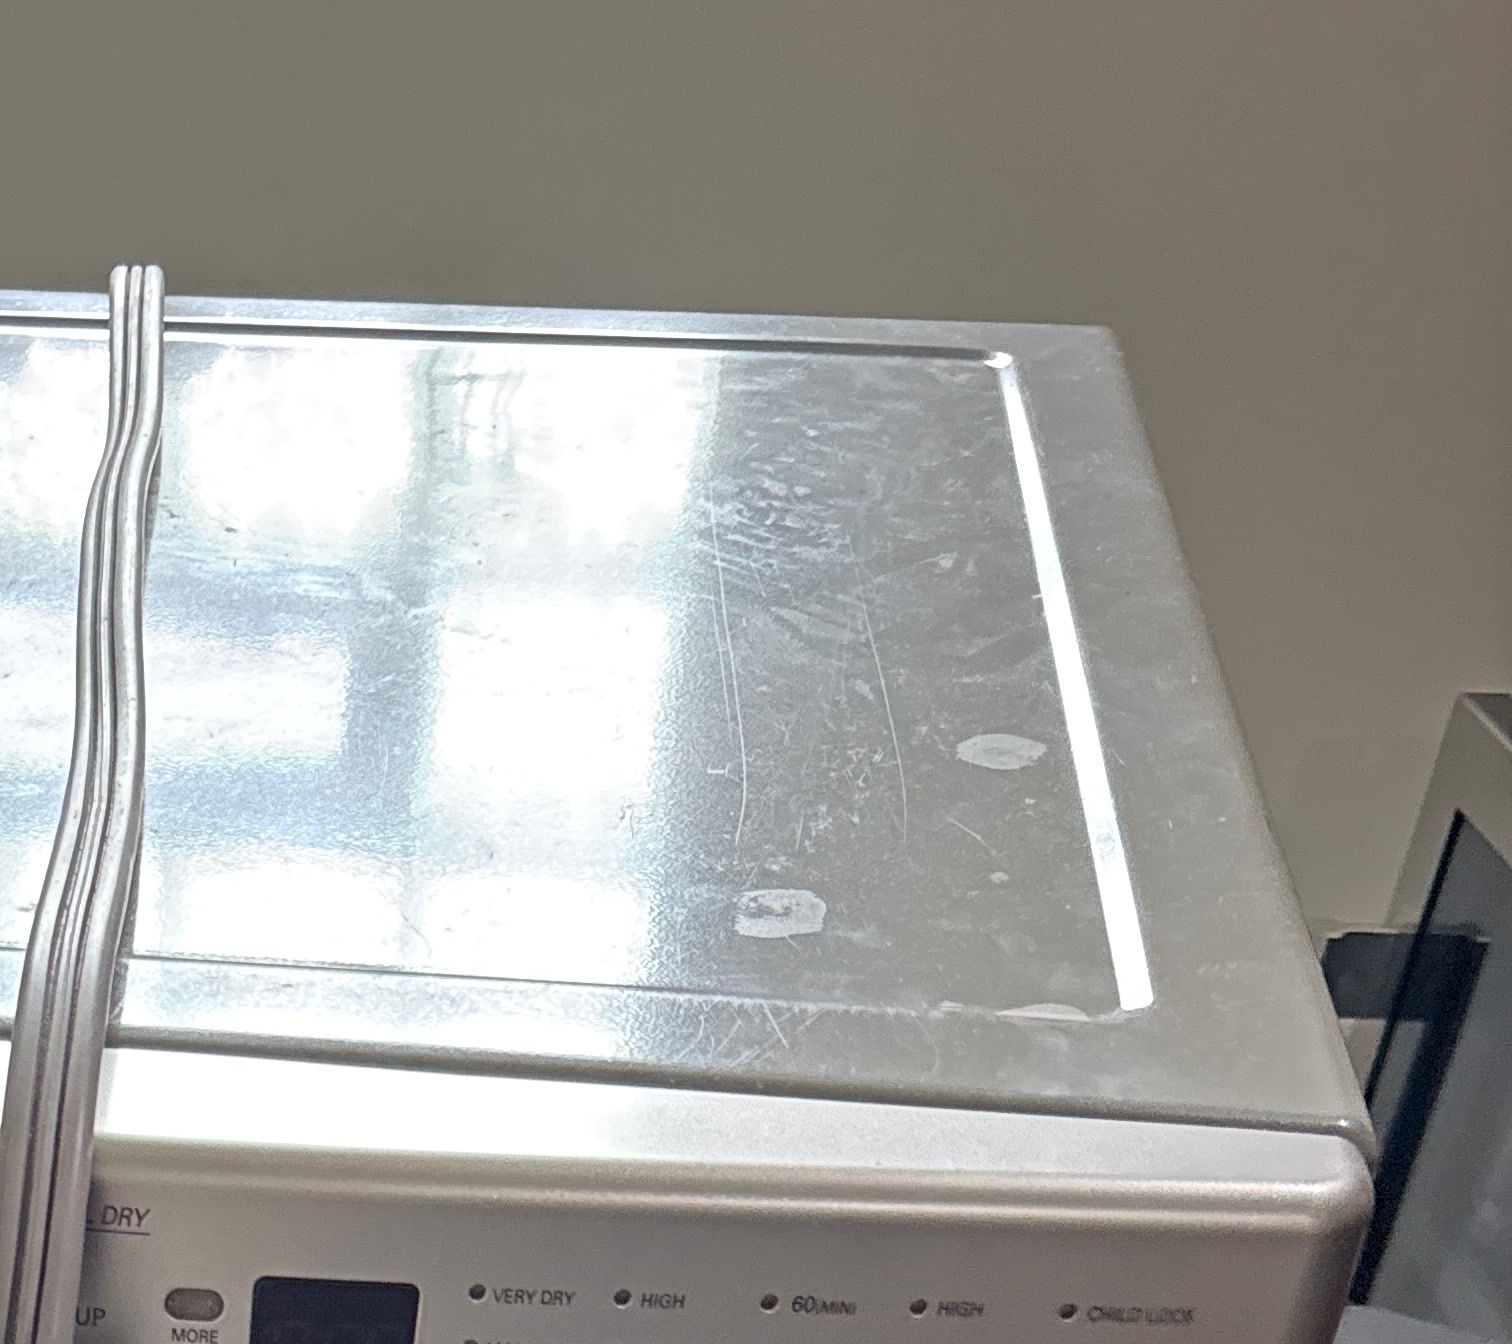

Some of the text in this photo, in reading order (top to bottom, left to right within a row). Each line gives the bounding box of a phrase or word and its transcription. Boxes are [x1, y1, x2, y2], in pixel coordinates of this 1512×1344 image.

[101, 1204, 152, 1228] DRY
[493, 1288, 576, 1307] VERY DRY
[641, 1293, 686, 1310] HIGH
[76, 1306, 106, 1327] UP
[937, 1300, 984, 1318] HIGH
[171, 1327, 219, 1344] MORE
